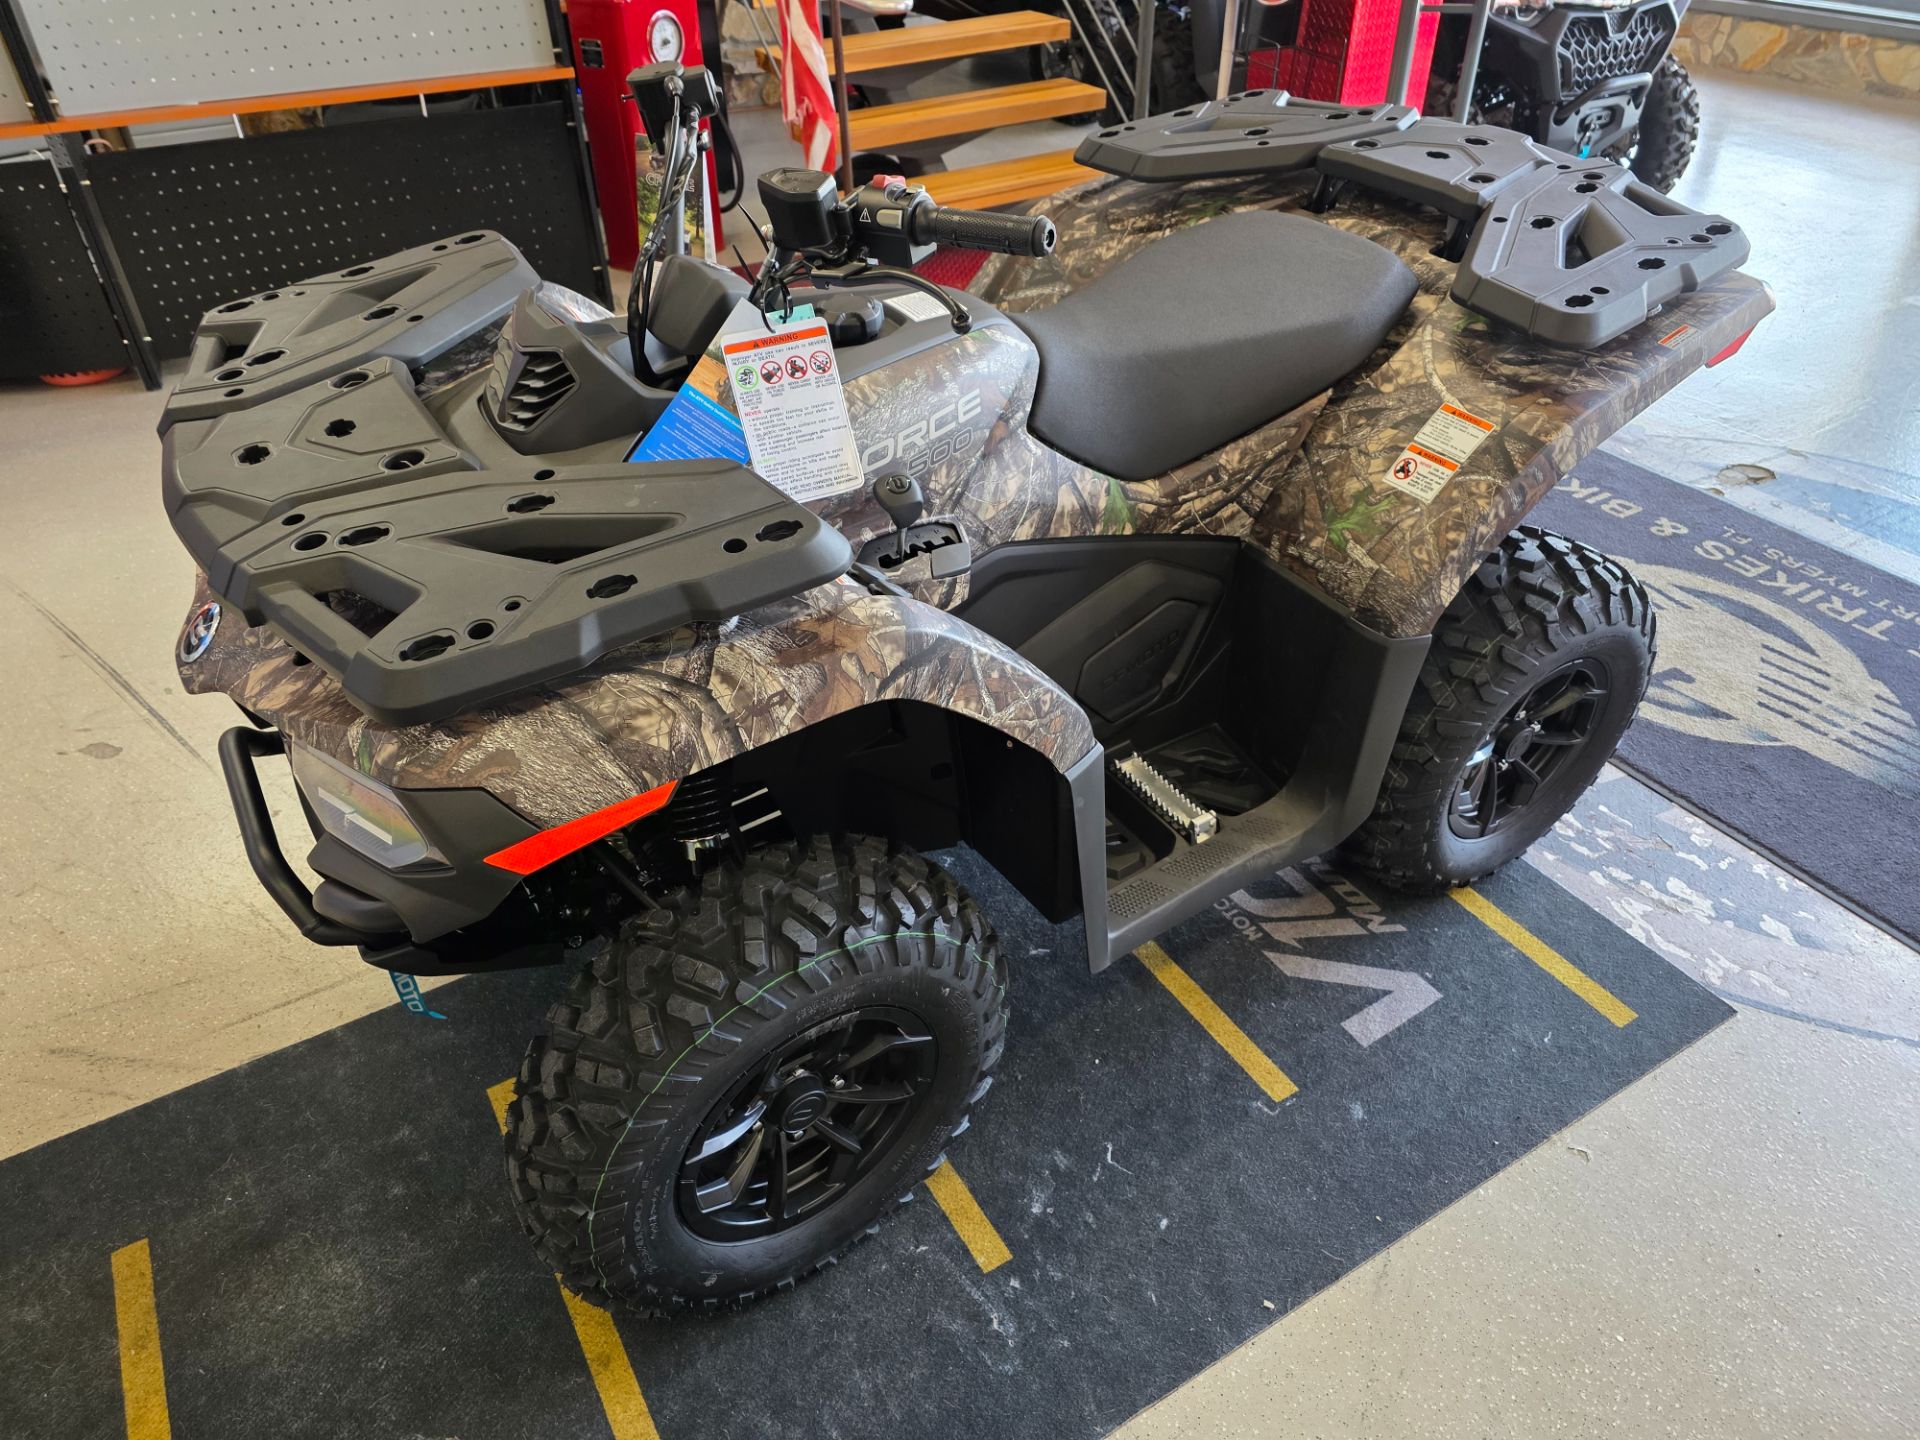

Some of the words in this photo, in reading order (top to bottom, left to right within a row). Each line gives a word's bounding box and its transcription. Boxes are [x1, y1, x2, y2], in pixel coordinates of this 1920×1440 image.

[760, 333, 798, 346] WARNING
[744, 409, 761, 417] NEVER
[1451, 408, 1483, 425] WARNING
[907, 426, 973, 476] 500
[1421, 450, 1447, 466] WARNING
[1553, 475, 1643, 519] BIK
[1650, 517, 1689, 537] &
[1722, 525, 1753, 545] FL
[1762, 543, 1871, 598] MYERS,
[1694, 539, 1894, 641] TRIKES
